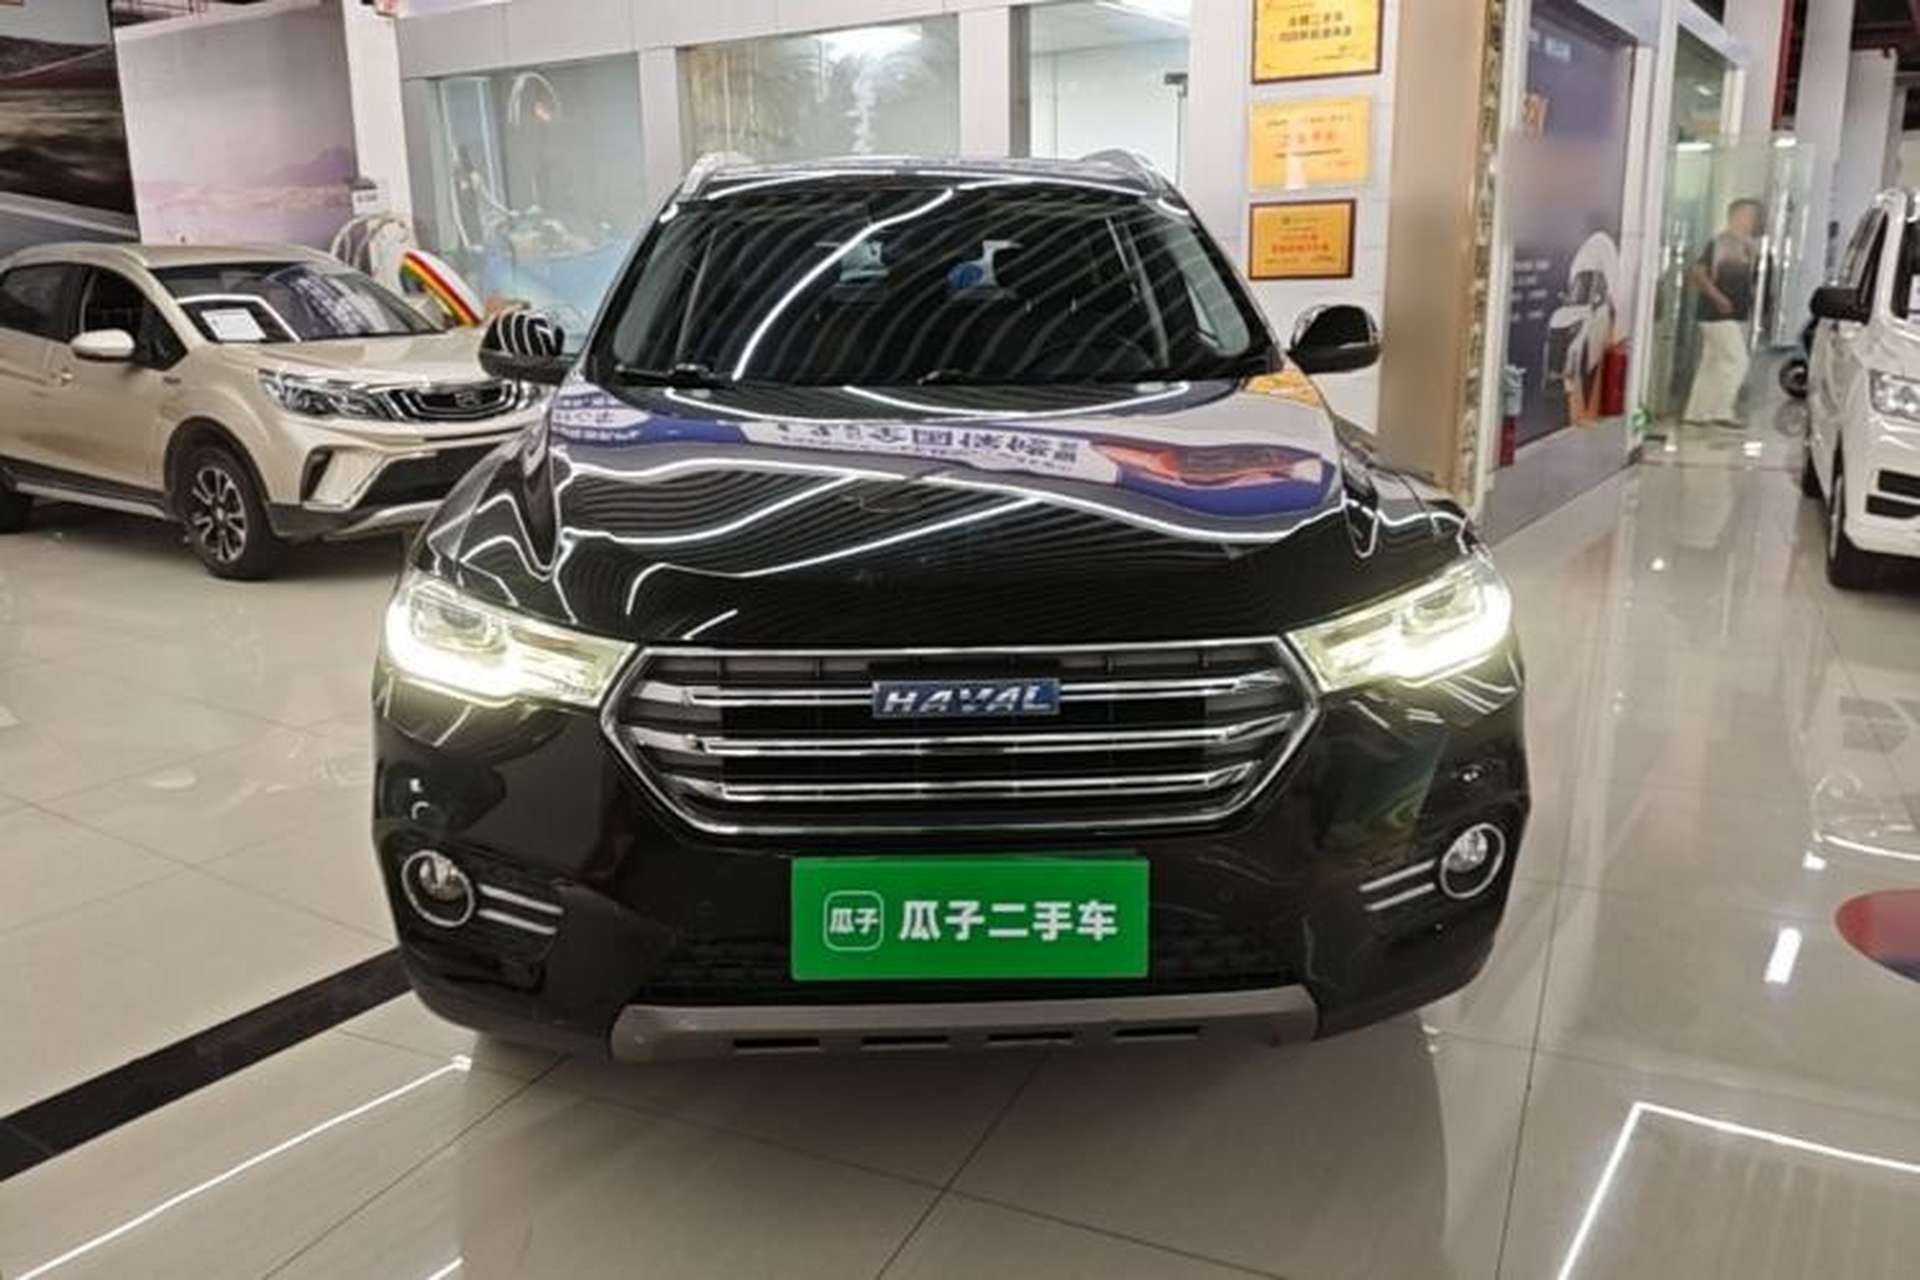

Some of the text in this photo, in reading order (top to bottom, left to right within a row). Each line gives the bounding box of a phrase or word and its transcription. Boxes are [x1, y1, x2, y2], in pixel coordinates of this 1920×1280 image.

[882, 685, 1051, 713] HAVAL
[829, 907, 879, 934] 瓜子
[899, 899, 1119, 941] 瓜子二手车
